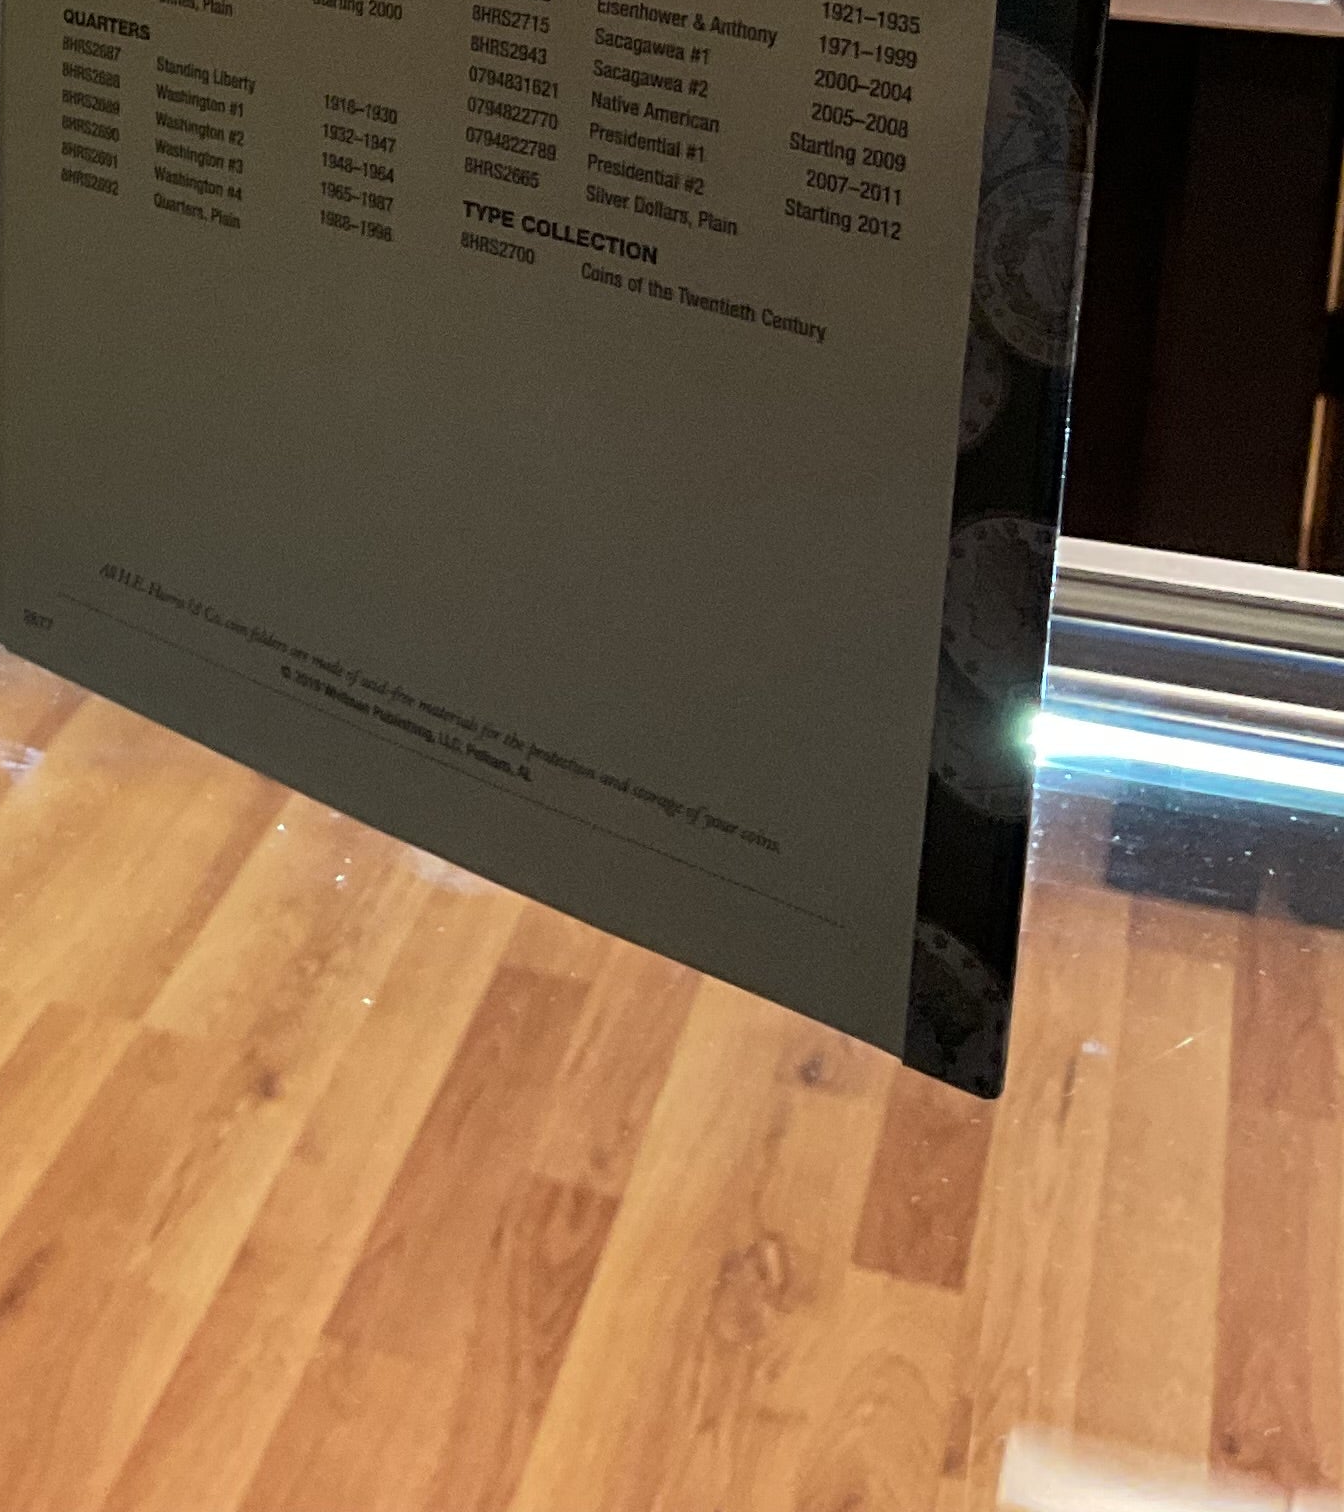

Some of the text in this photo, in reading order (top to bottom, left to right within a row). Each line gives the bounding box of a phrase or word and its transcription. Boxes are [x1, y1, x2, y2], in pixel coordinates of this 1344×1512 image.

[64, 9, 150, 40] QUARTERS
[693, 12, 705, 30] &
[711, 17, 777, 49] Anthony
[595, 29, 711, 65] Sacagawea #1
[157, 57, 255, 95] Standing Liberty
[591, 92, 719, 133] Native American
[590, 123, 705, 162] Presidential #1
[789, 133, 906, 172] Starting 2009
[586, 185, 738, 236] Silver Dollars, Plain
[785, 199, 901, 240] Starting 2012
[463, 200, 657, 265] TYPE COLLECTION
[581, 262, 826, 343] Coins of the Twentieth Century
